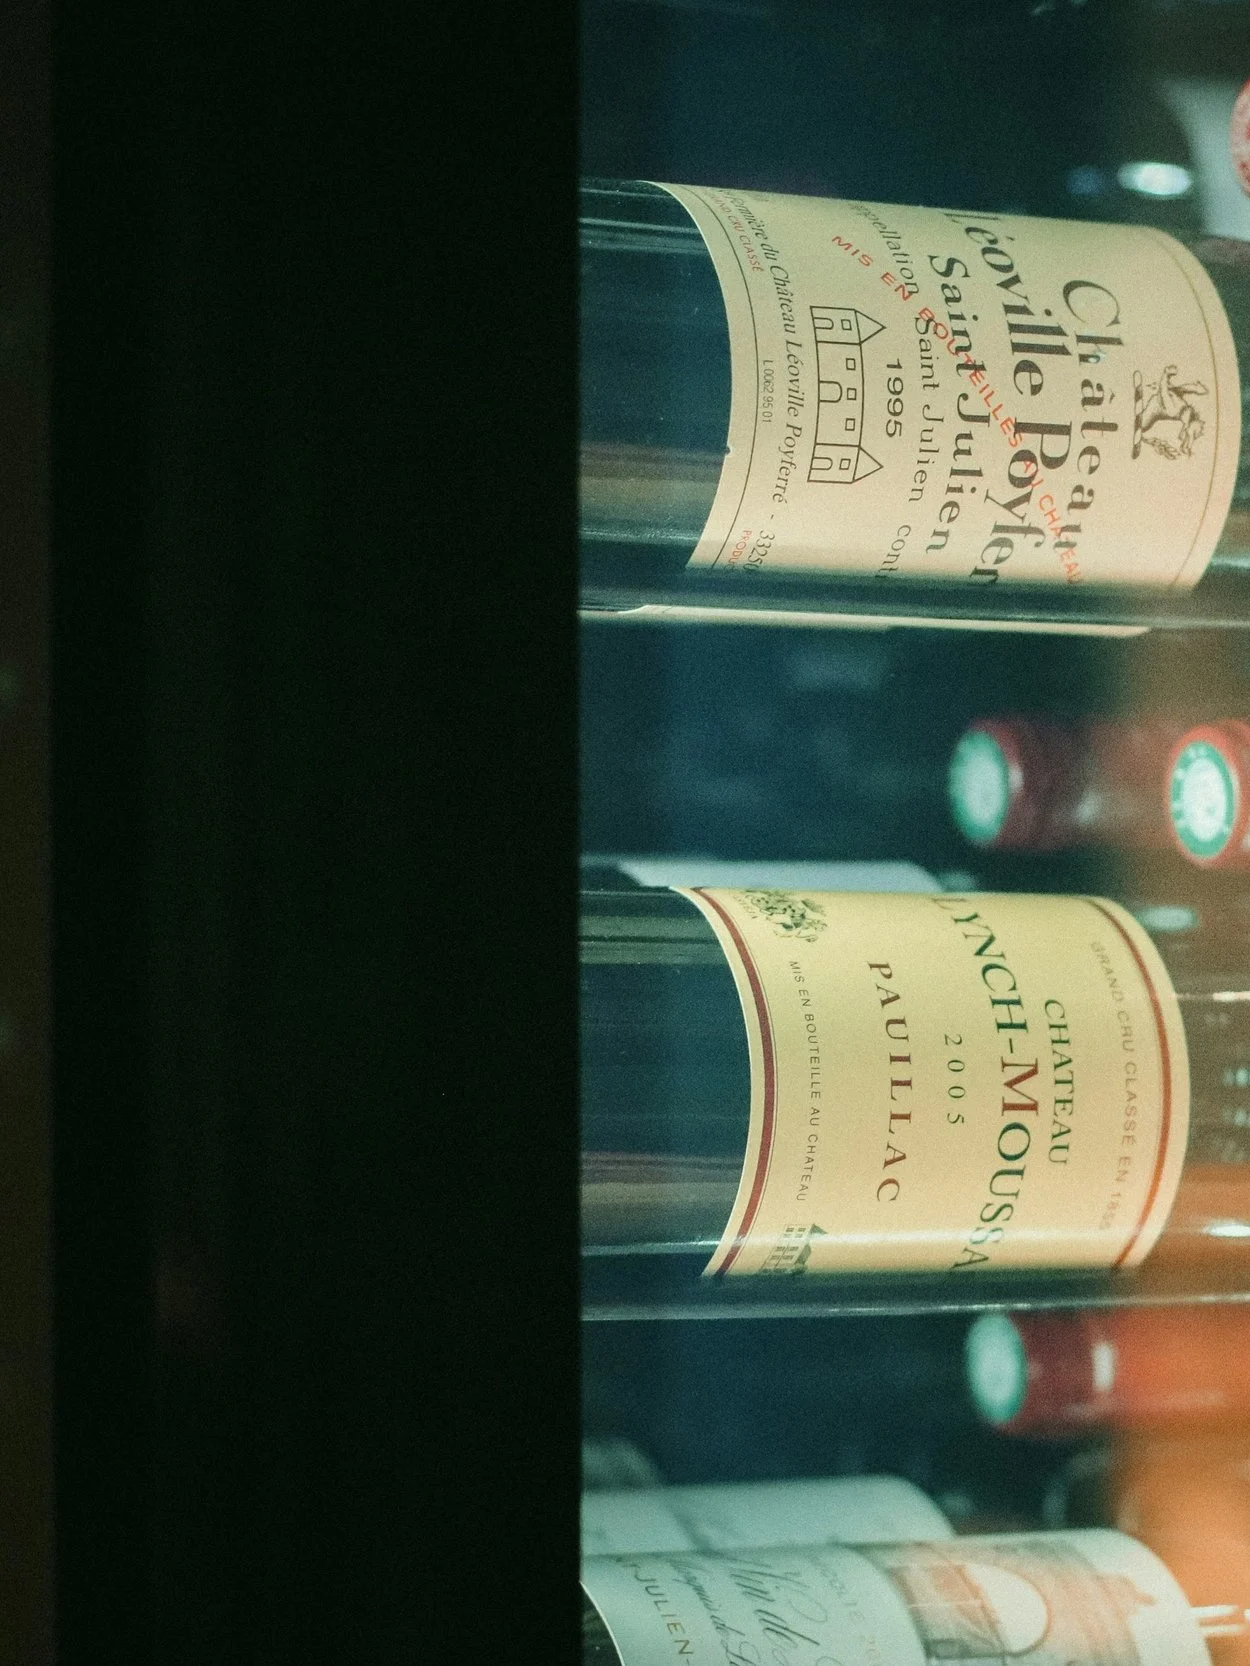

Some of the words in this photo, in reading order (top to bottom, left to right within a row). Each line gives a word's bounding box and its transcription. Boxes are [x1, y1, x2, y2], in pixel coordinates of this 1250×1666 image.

[759, 243, 780, 261] du
[769, 265, 797, 335] Château
[927, 255, 987, 377] Saint
[943, 213, 1072, 396] Léoville
[762, 368, 774, 394] 0062
[785, 339, 804, 418] Léoville
[832, 235, 874, 268] MIS
[880, 272, 913, 302] EN
[918, 307, 1023, 449] BOUTEILLES
[1022, 459, 1044, 489] AU
[914, 317, 939, 391] Saint
[761, 396, 773, 408] 95
[885, 358, 905, 438] 1995
[1053, 280, 1125, 552] Château
[772, 422, 803, 504] Poyferré
[908, 404, 944, 502] Julien
[925, 393, 991, 554] Julien
[788, 961, 805, 983] MIS
[798, 989, 812, 1008] EN
[1090, 942, 1124, 1002] GRAND
[803, 1013, 821, 1099] BOUTEILLE
[1116, 1010, 1134, 1051] CRU
[809, 1107, 821, 1127] AU
[867, 961, 913, 1203] PAUILLAC
[943, 1034, 966, 1125] 2005
[1044, 999, 1074, 1165] CHATEAU
[1121, 1062, 1138, 1146] CLASSÉ
[796, 1134, 819, 1201] CHATEAU
[1115, 1156, 1131, 1183] EN
